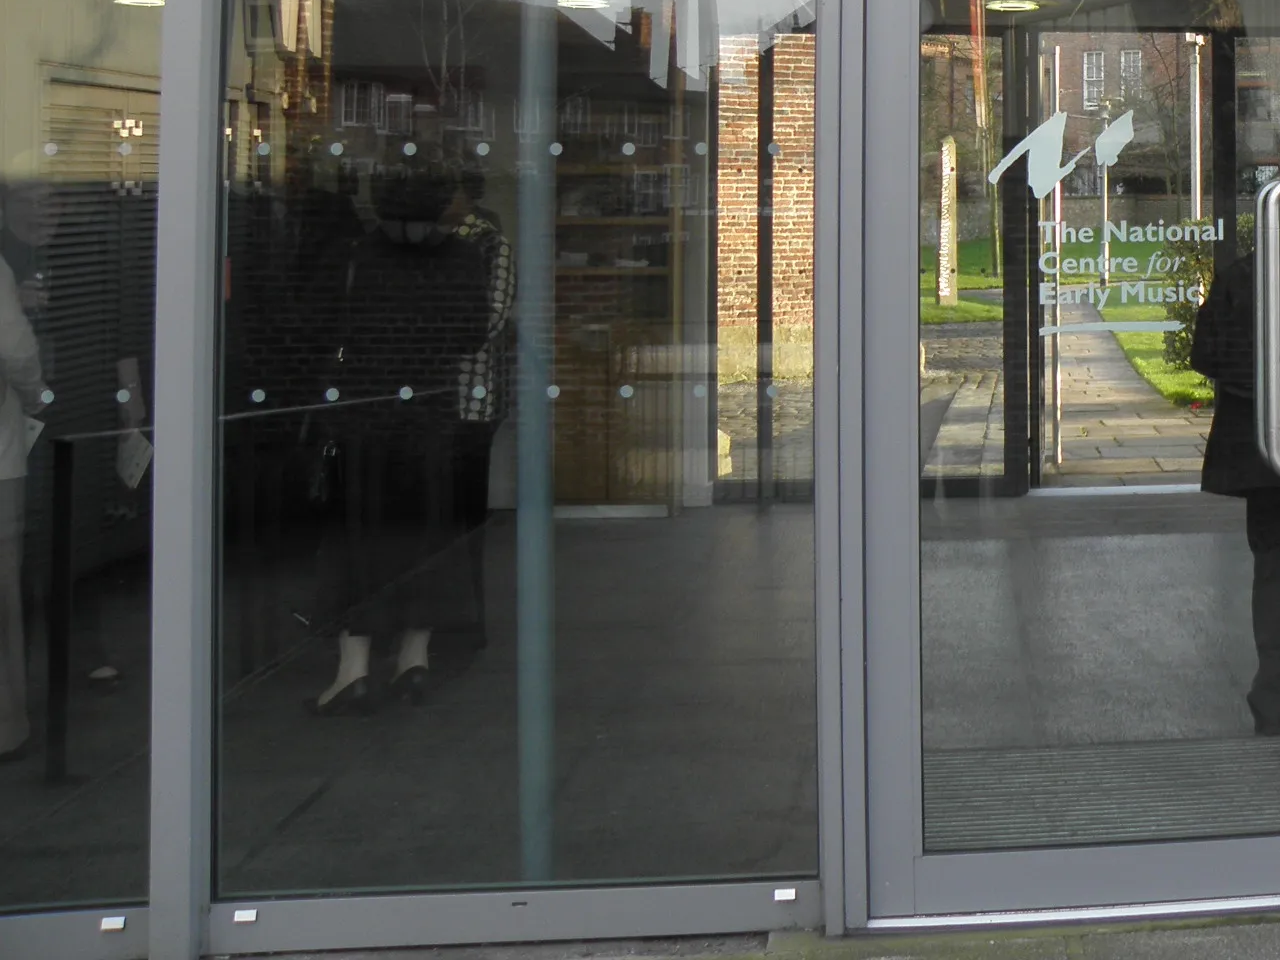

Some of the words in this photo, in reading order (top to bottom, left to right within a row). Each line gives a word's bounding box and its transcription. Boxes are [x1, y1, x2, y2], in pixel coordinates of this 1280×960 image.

[1038, 220, 1093, 243] The
[1106, 219, 1225, 242] National
[1038, 251, 1138, 275] Centre
[1144, 251, 1186, 278] for
[1039, 281, 1110, 310] Early
[1121, 280, 1203, 304] Music
